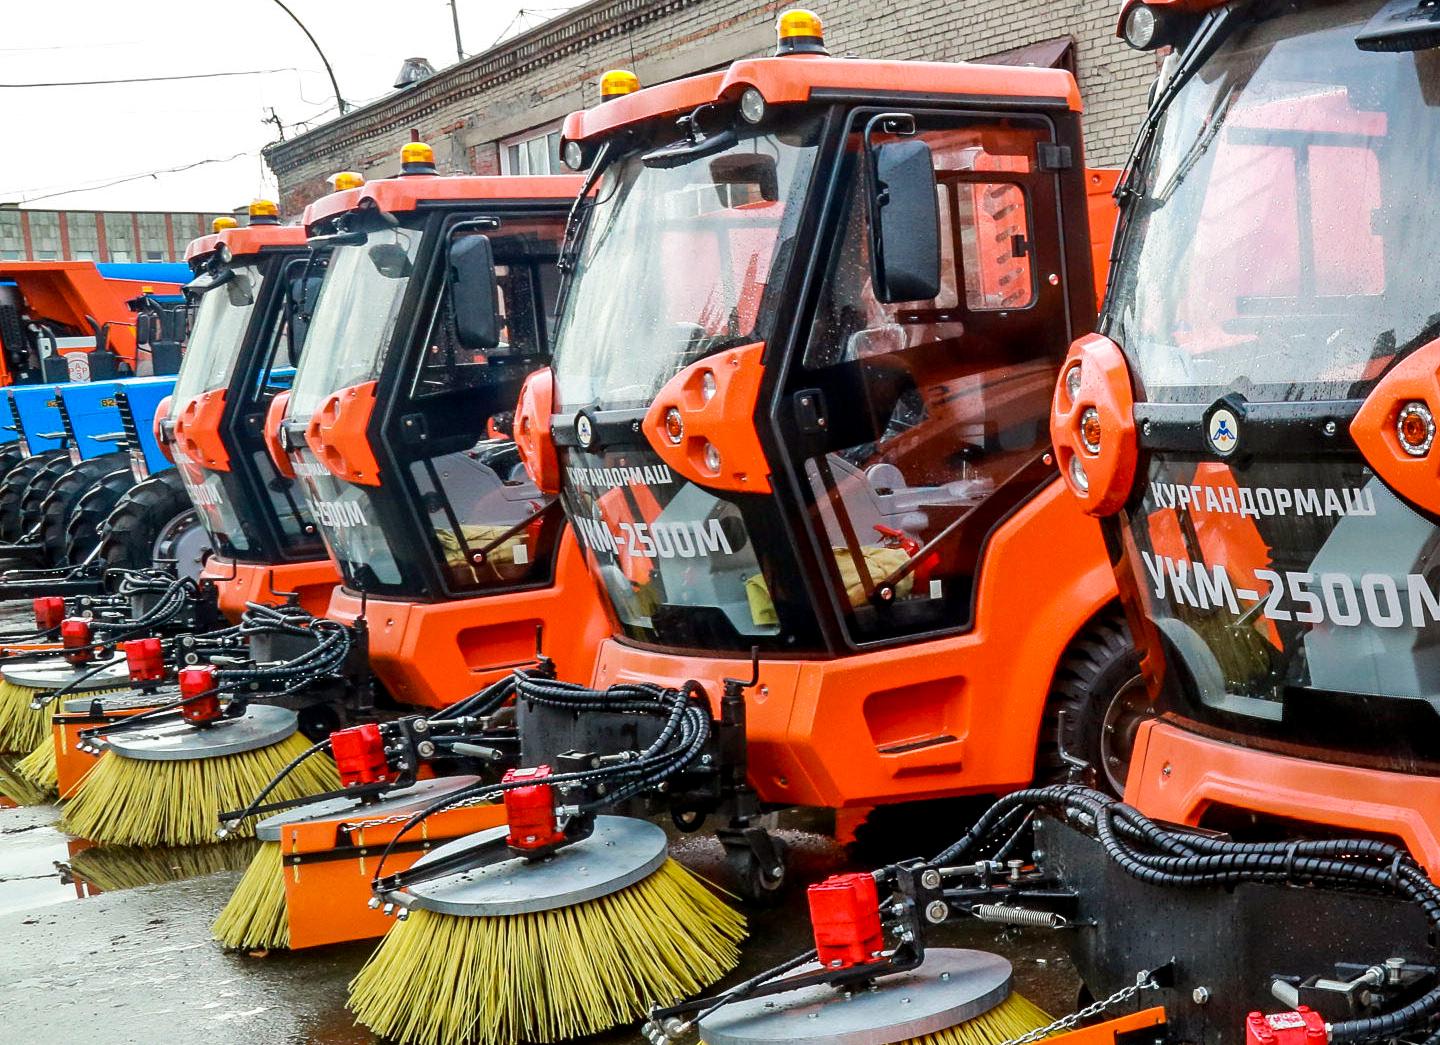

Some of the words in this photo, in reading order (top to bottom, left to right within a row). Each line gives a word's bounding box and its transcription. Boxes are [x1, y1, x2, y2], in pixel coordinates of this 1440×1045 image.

[566, 464, 672, 489] КУРГАНДОРМАШ
[1151, 482, 1376, 519] КУРГАНДОРМАШ
[573, 515, 733, 558] УКМ-2500М
